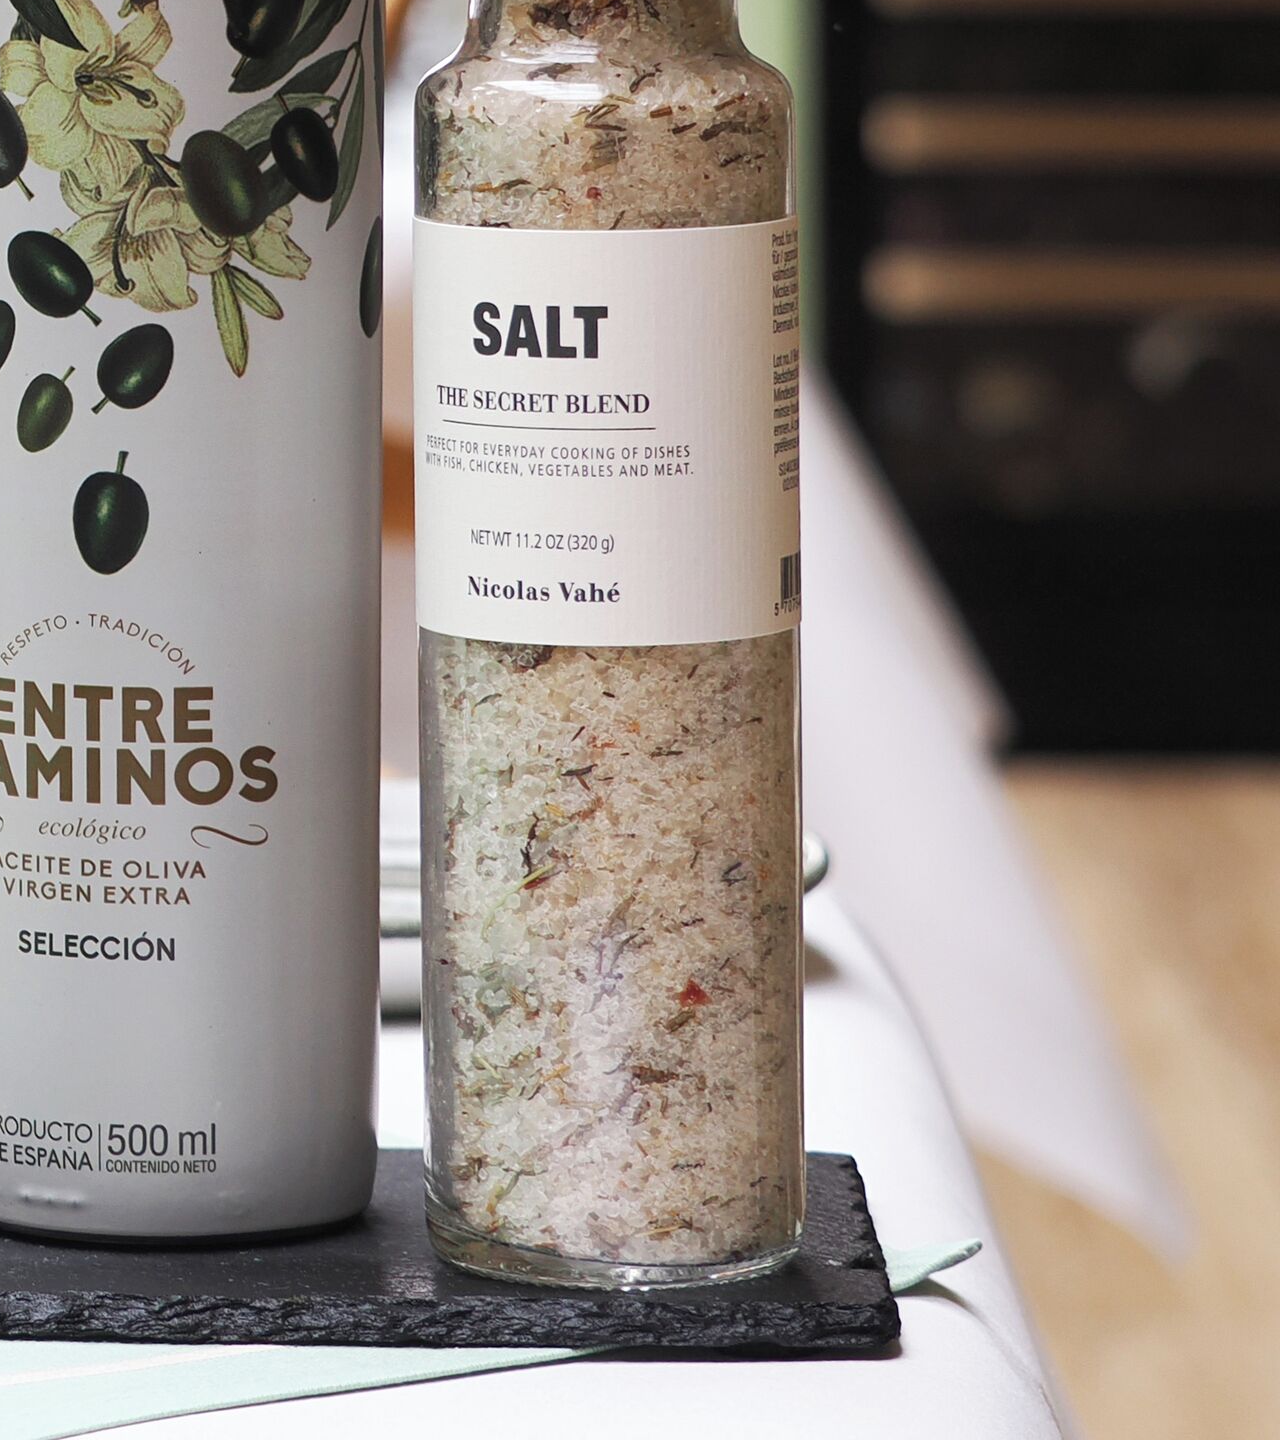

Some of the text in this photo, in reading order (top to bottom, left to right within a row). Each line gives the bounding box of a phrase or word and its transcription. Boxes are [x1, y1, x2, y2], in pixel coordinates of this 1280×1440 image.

[473, 301, 609, 359] SALT
[437, 385, 650, 414] THE SECRET BLEND
[426, 434, 690, 460] PERFECT FOR EVERYDAY COOKING OF DISHES
[425, 452, 694, 477] WITH FISH, CHICKEN, VEGETABLES AND MEAT.
[470, 528, 615, 554] NET WT 11.2 OZ (320 g)
[467, 575, 621, 603] Nicolas Vahé
[0, 613, 196, 676] RESPETO TRADICIÓN
[39, 817, 147, 845] ecológico
[80, 858, 112, 878] DE
[122, 860, 206, 879] OLIVA
[3, 876, 191, 905] VIRGEN EXTRA
[18, 929, 176, 961] SELECCIÓN
[107, 1123, 216, 1156] 500 ml
[13, 1144, 94, 1172] ESPAÑA
[105, 1159, 217, 1174] CONTENIDO NETO
